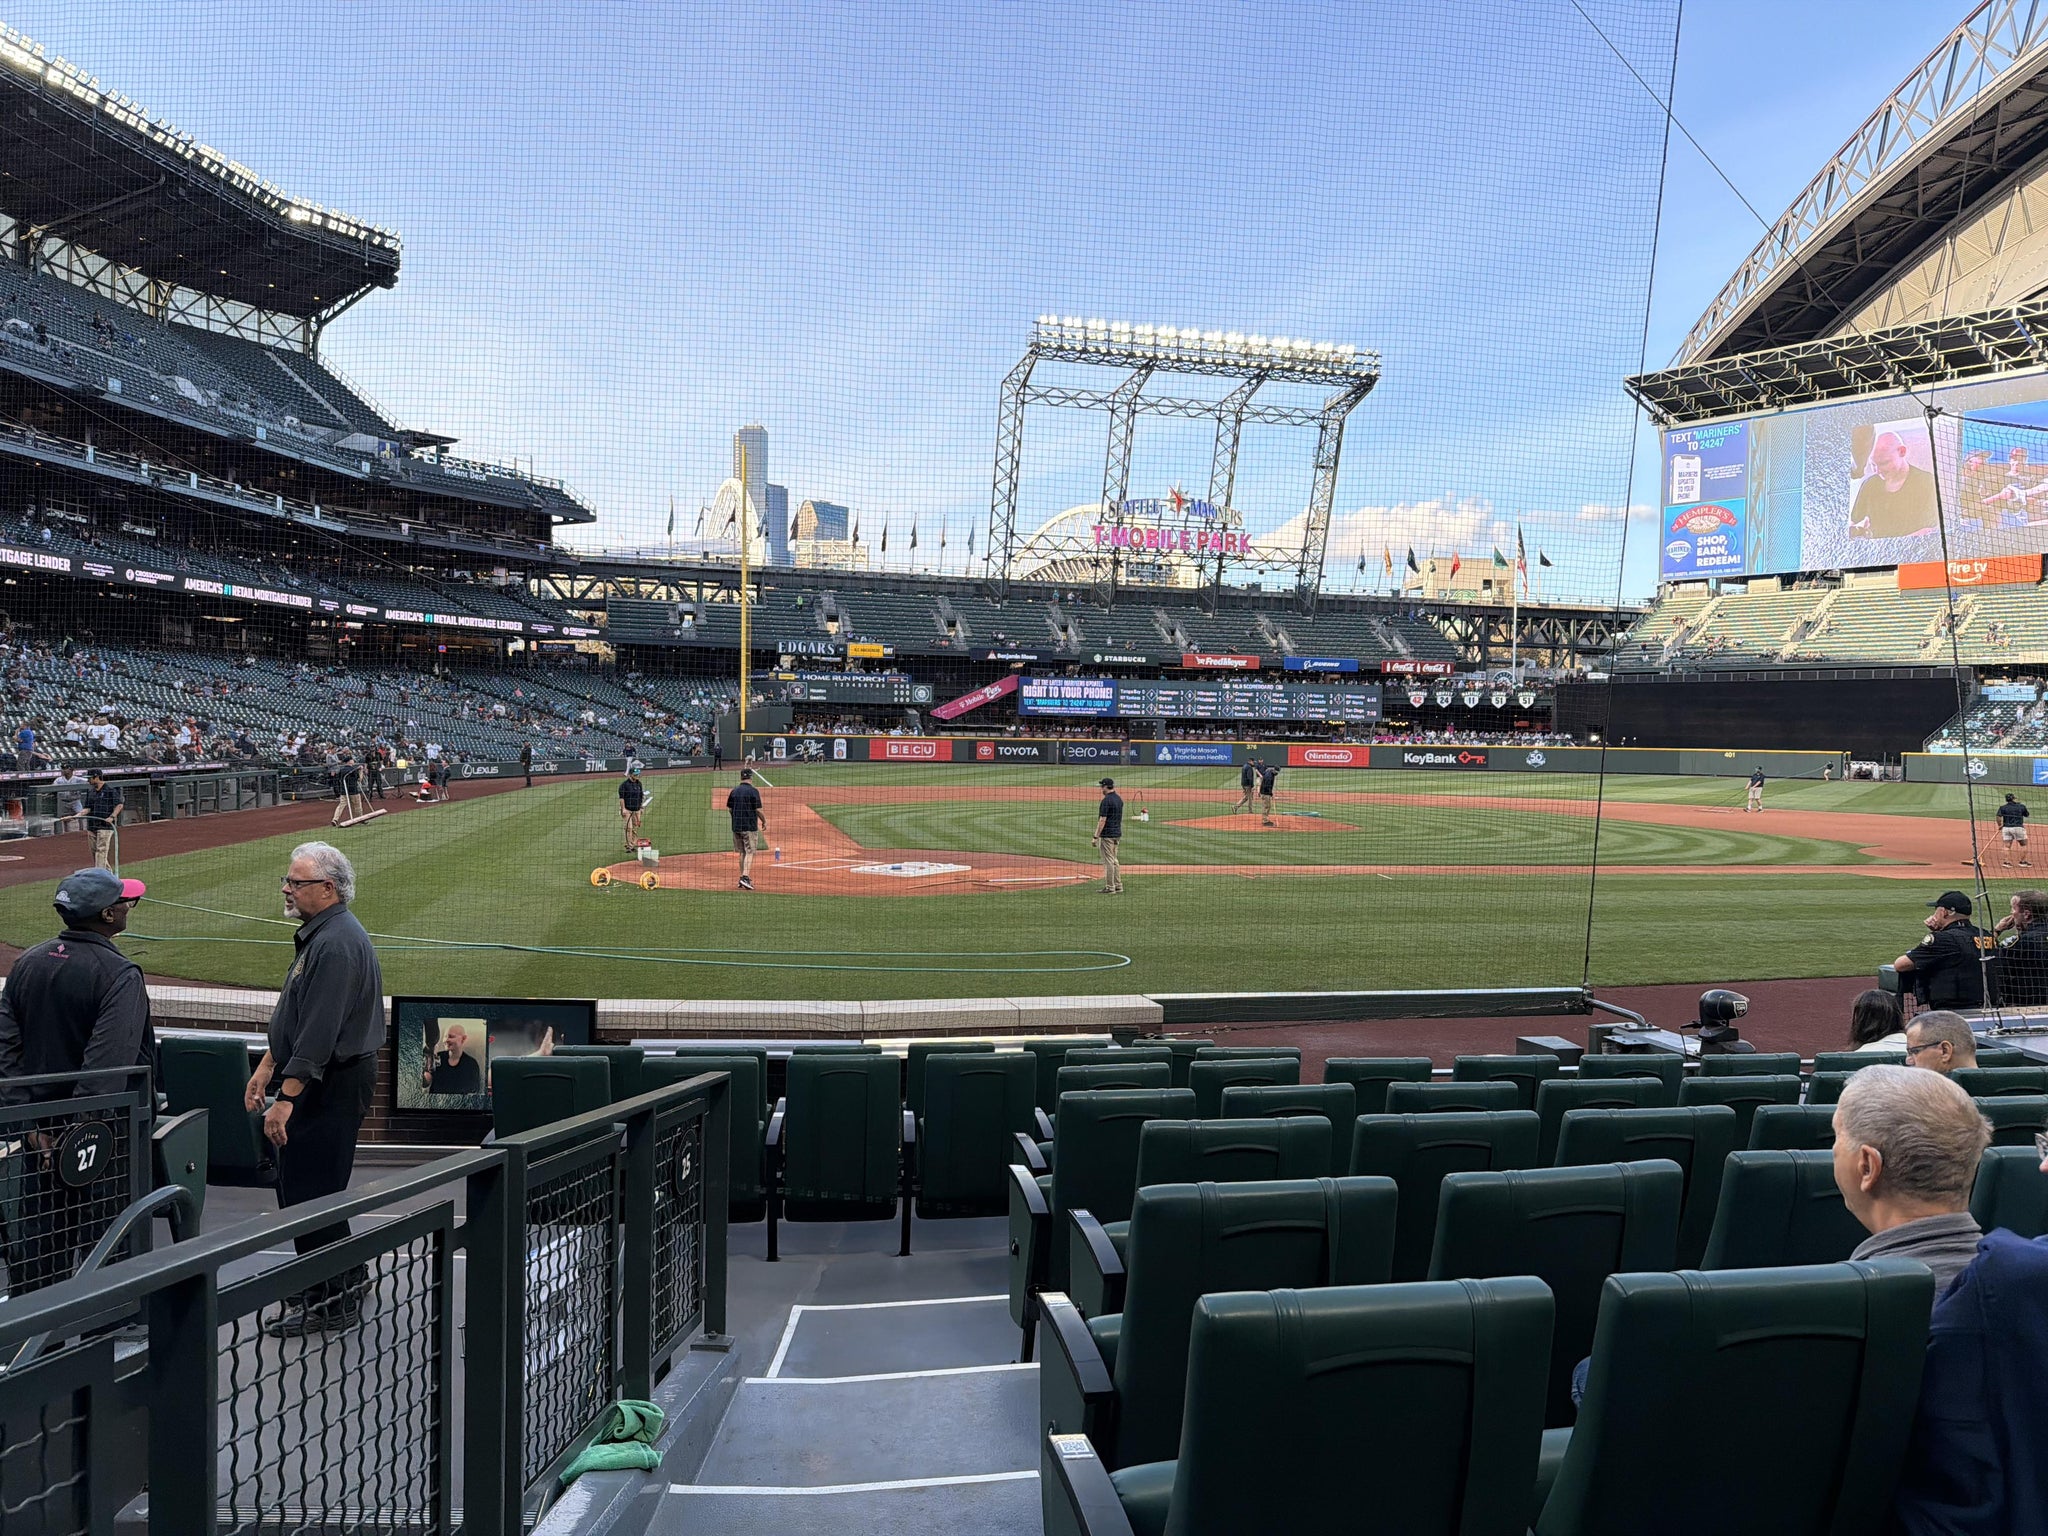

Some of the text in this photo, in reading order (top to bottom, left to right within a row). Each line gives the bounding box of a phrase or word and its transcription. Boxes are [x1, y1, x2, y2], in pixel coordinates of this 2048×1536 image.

[1671, 432, 1692, 443] TEXT
[1688, 438, 1724, 451] TO 24247
[470, 472, 486, 480] Deck
[1108, 498, 1243, 526] SEATTLE MARINERS
[1679, 508, 1730, 524] HEMPLER'S
[1092, 525, 1252, 553] T-MOBILE PARK
[1697, 535, 1728, 546] SHOP,
[1697, 546, 1728, 556] EARN,
[34, 554, 71, 572] LENDER
[1697, 555, 1740, 567] REDEEM!
[1948, 562, 1987, 574] fire tv
[185, 578, 223, 595] AMERICA'S
[224, 585, 232, 596] #1
[232, 586, 255, 599] RETAIL
[255, 588, 289, 604] MORTGAGE
[289, 595, 312, 608] LENDER
[385, 610, 424, 623] AMERICA'S
[425, 613, 433, 623] #1
[434, 614, 458, 626] RETAIL
[458, 616, 496, 629] MORTGAGE
[497, 620, 523, 632] LENDER
[778, 642, 834, 654] EDGARS
[1104, 655, 1146, 663] STARBUCKS
[1023, 686, 1112, 699] RIGHT TO YOUR PHONE!
[892, 746, 932, 754] BECU
[998, 747, 1038, 756] TOYOTA
[1404, 753, 1456, 765] KeyBank
[472, 765, 498, 775] LEXUS
[585, 760, 608, 771] STIHL
[78, 1144, 96, 1172] 27
[682, 1152, 690, 1180] 25
